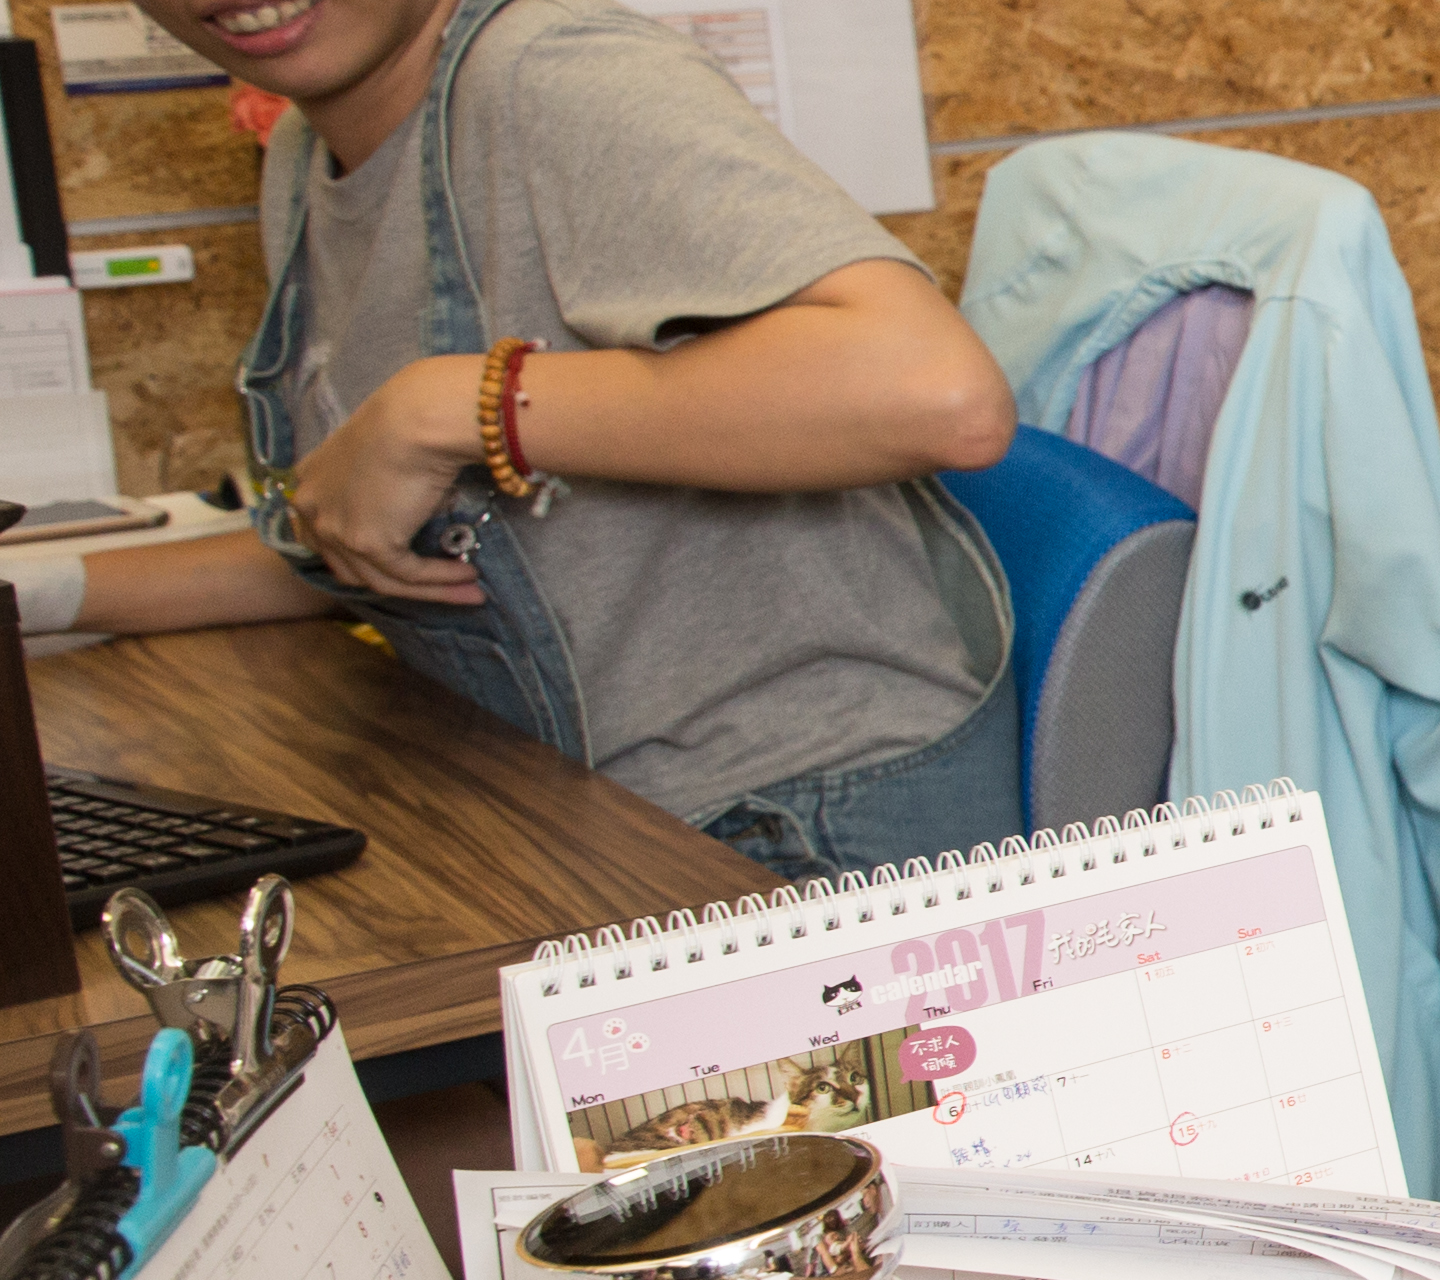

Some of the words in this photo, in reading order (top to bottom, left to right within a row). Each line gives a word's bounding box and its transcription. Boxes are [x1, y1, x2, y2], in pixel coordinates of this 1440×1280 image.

[1236, 925, 1263, 940] Sun
[1136, 949, 1163, 966] Sat
[1244, 945, 1254, 956] 2
[890, 909, 1047, 1026] 2017
[870, 959, 983, 1006] calendar
[1032, 976, 1055, 993] Fri
[923, 1004, 952, 1020] Thu
[1262, 1021, 1273, 1033] 9
[808, 1031, 840, 1048] Wed
[1161, 1047, 1172, 1060] 8
[690, 1062, 721, 1079] Tue
[1056, 1076, 1067, 1088] 7
[571, 1090, 606, 1109] Mon
[1279, 1096, 1297, 1108] 16
[949, 1105, 959, 1118] 6
[1177, 1124, 1197, 1138] 15
[1074, 1154, 1093, 1168] 14
[1294, 1171, 1313, 1186] 23
